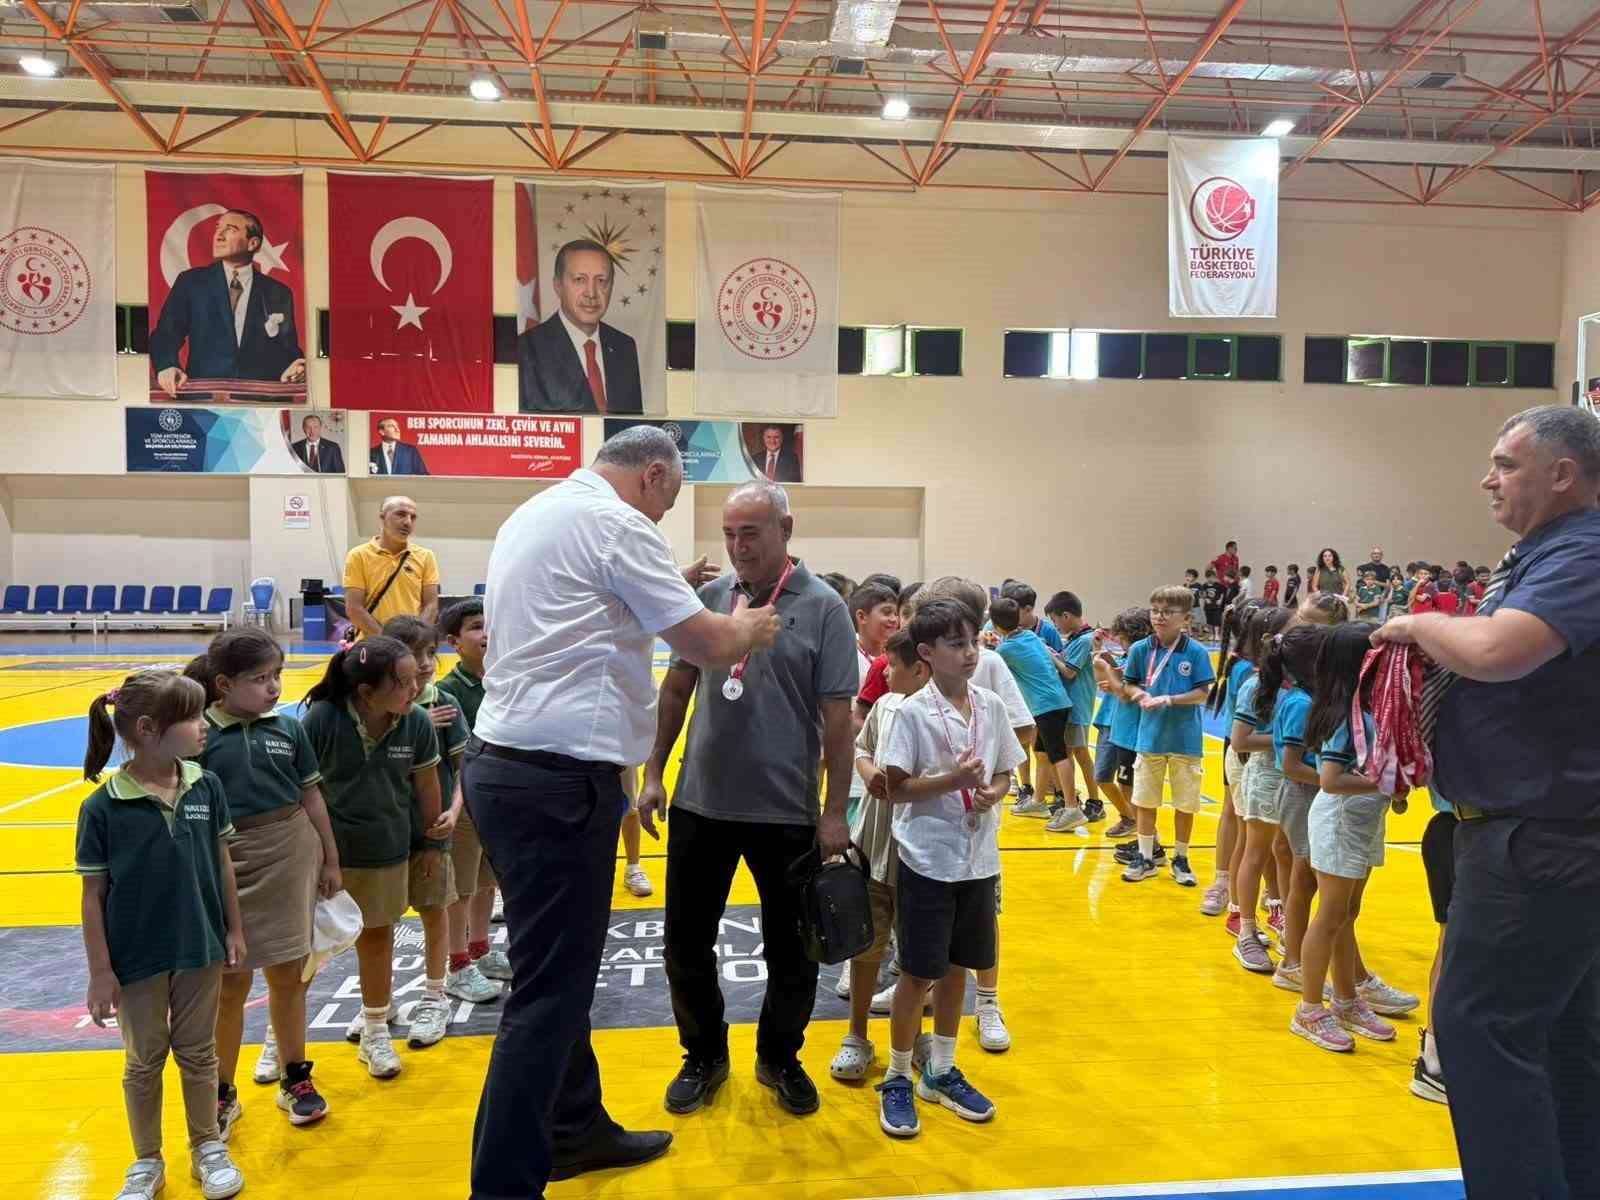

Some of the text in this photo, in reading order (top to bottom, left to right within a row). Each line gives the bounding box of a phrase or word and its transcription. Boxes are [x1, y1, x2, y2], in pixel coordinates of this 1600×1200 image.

[1190, 244, 1255, 260] TÜRKİYE
[1190, 261, 1256, 271] BASKETBOL
[1190, 271, 1256, 279] FEDERASYONU
[407, 415, 576, 434] BEN SPORCUNUN ZEKİ, ÇEVİK VE AYNI
[417, 432, 566, 448] ZAMANDA AHLAKLISINI SEVERİM.
